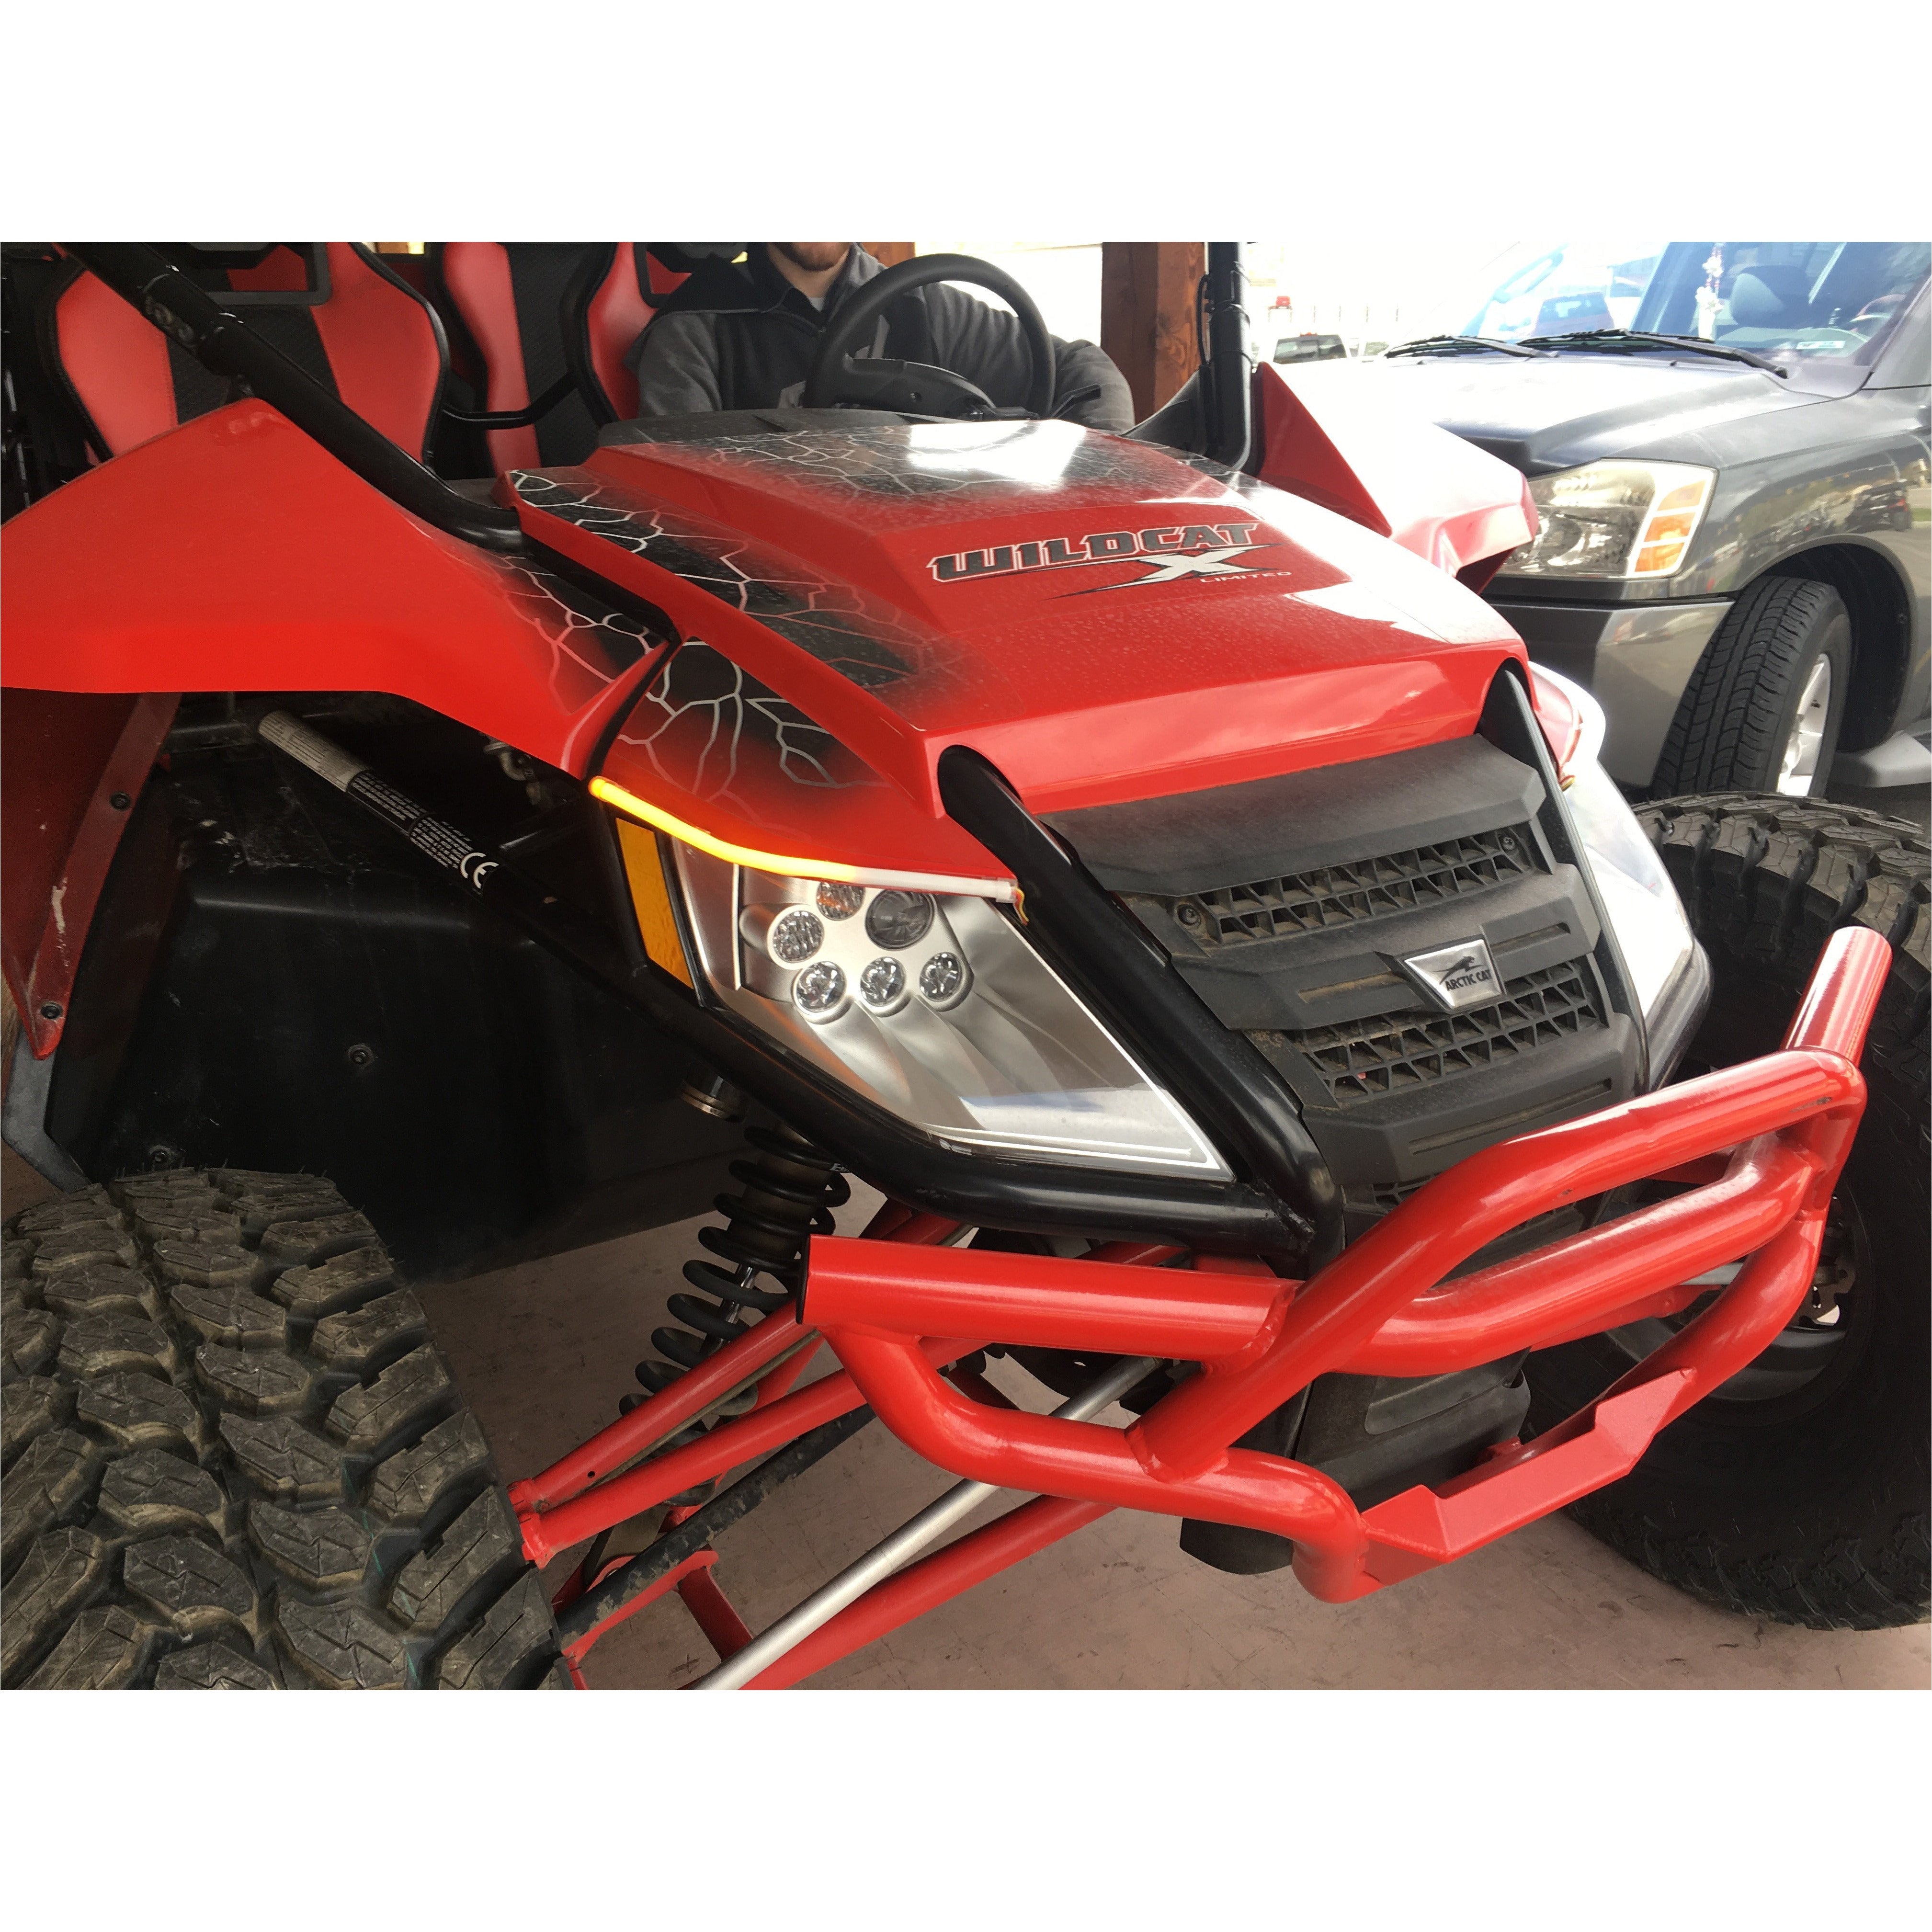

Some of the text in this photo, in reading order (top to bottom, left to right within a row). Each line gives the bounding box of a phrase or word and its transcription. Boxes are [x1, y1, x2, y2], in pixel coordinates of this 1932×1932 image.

[926, 523, 1259, 583] WILDCAT
[1068, 543, 1286, 597] X
[1200, 571, 1293, 583] LIMITED
[460, 852, 499, 889] CE
[1445, 969, 1492, 991] ARCTIC CAT
